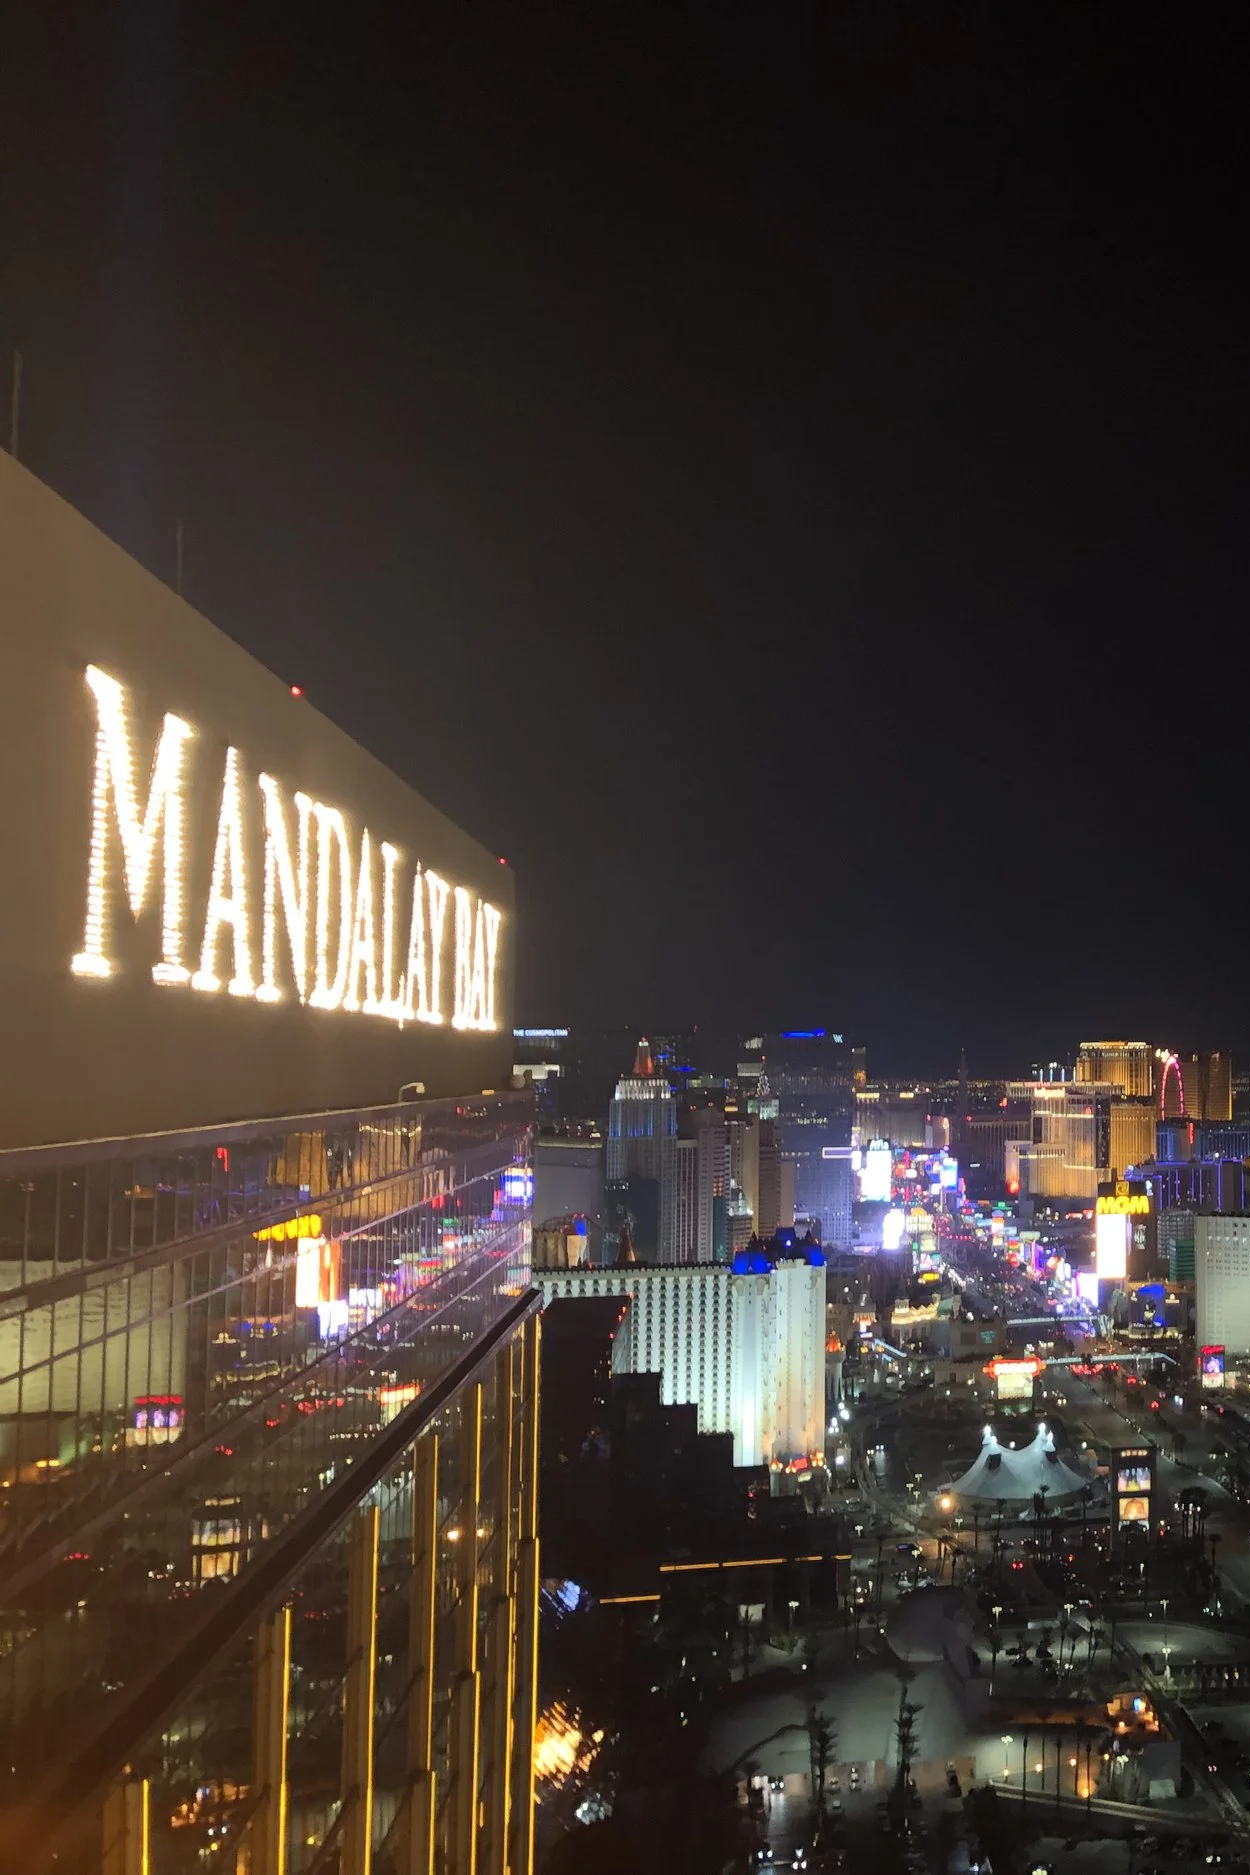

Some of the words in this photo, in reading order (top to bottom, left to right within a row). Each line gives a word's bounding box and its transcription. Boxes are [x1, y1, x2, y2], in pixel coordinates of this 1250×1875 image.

[71, 664, 450, 1026] MANDALAY
[452, 886, 501, 1031] BAY
[513, 1029, 524, 1037] THE
[525, 1028, 568, 1037] COSMOPOLITAN
[1096, 1195, 1150, 1215] MGM
